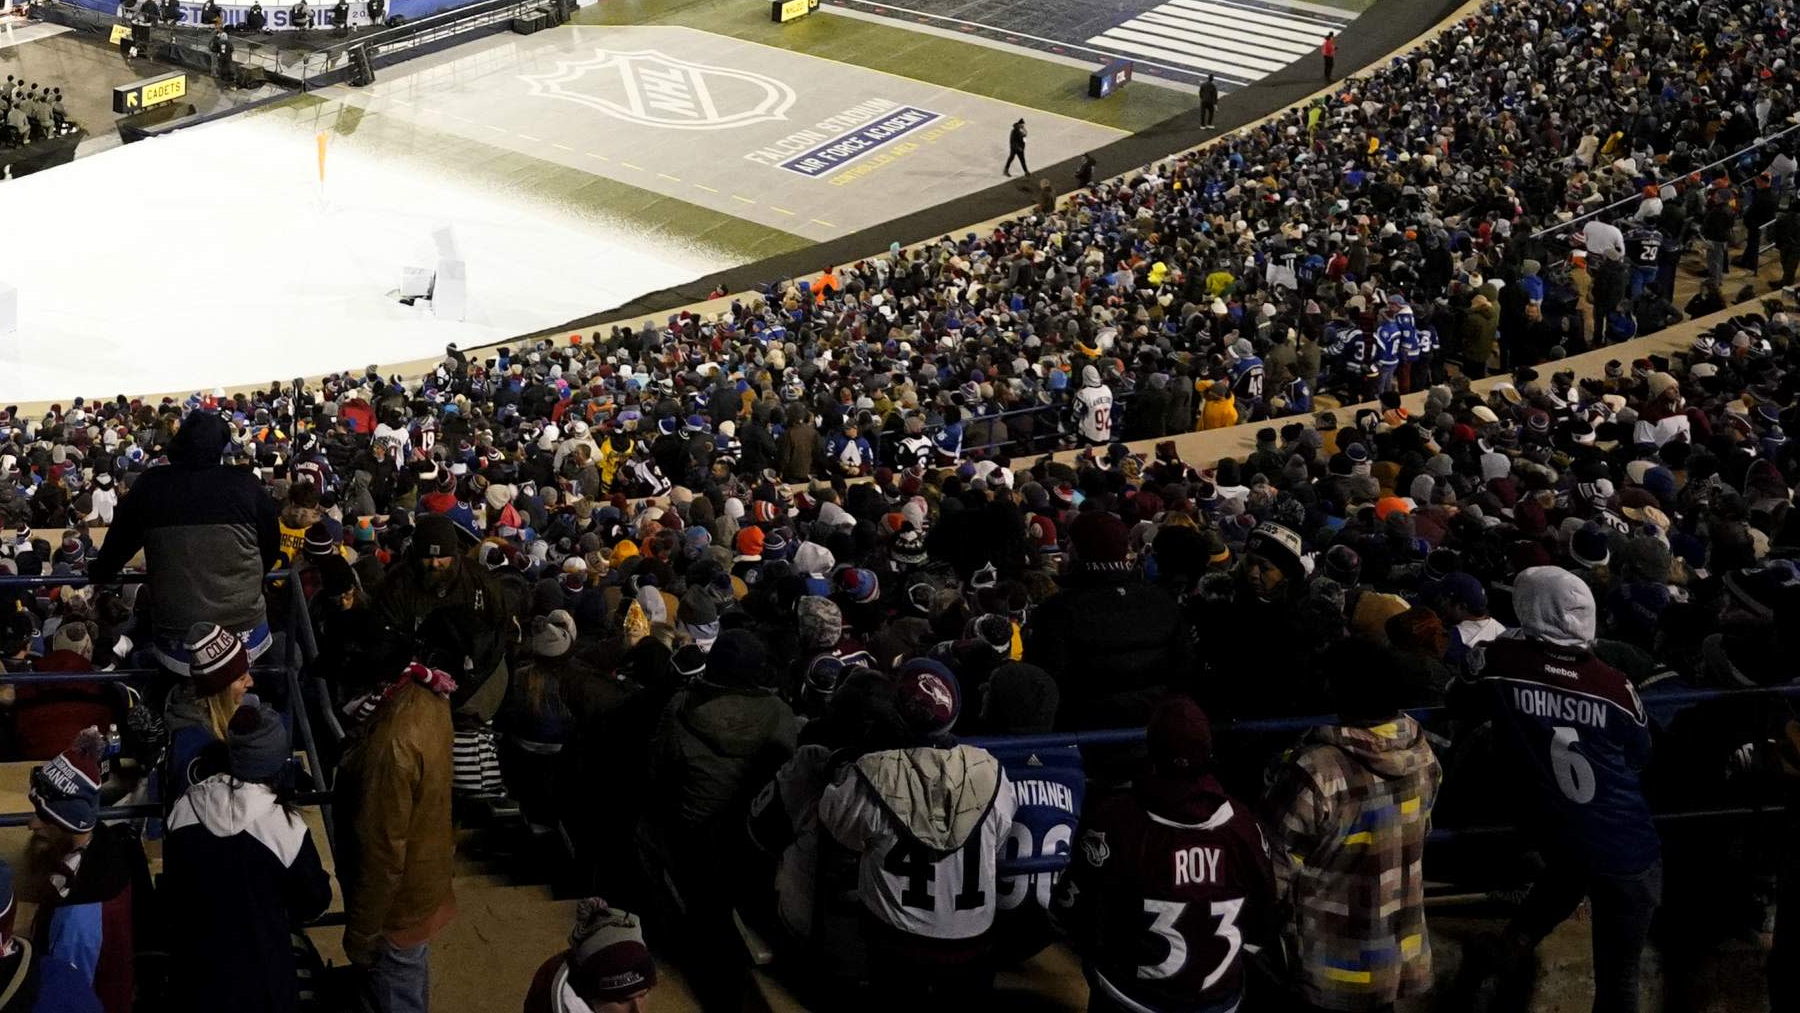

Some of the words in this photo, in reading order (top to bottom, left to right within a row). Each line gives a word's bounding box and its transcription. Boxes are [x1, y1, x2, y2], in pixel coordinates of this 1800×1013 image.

[146, 81, 182, 101] CADETS
[637, 64, 699, 118] NHL
[743, 129, 827, 166] FALCON
[815, 97, 901, 134] STADIUM
[794, 157, 828, 175] AIR
[817, 136, 874, 162] FORCE
[864, 109, 930, 142] ACADEMY
[1640, 245, 1659, 261] 29
[1544, 663, 1580, 680] Reebok
[1513, 686, 1608, 730] JOHNSON
[1550, 726, 1598, 805] 6
[1014, 781, 1074, 813] NTANEN
[1175, 846, 1221, 886] ROY
[1137, 896, 1247, 993] 33
